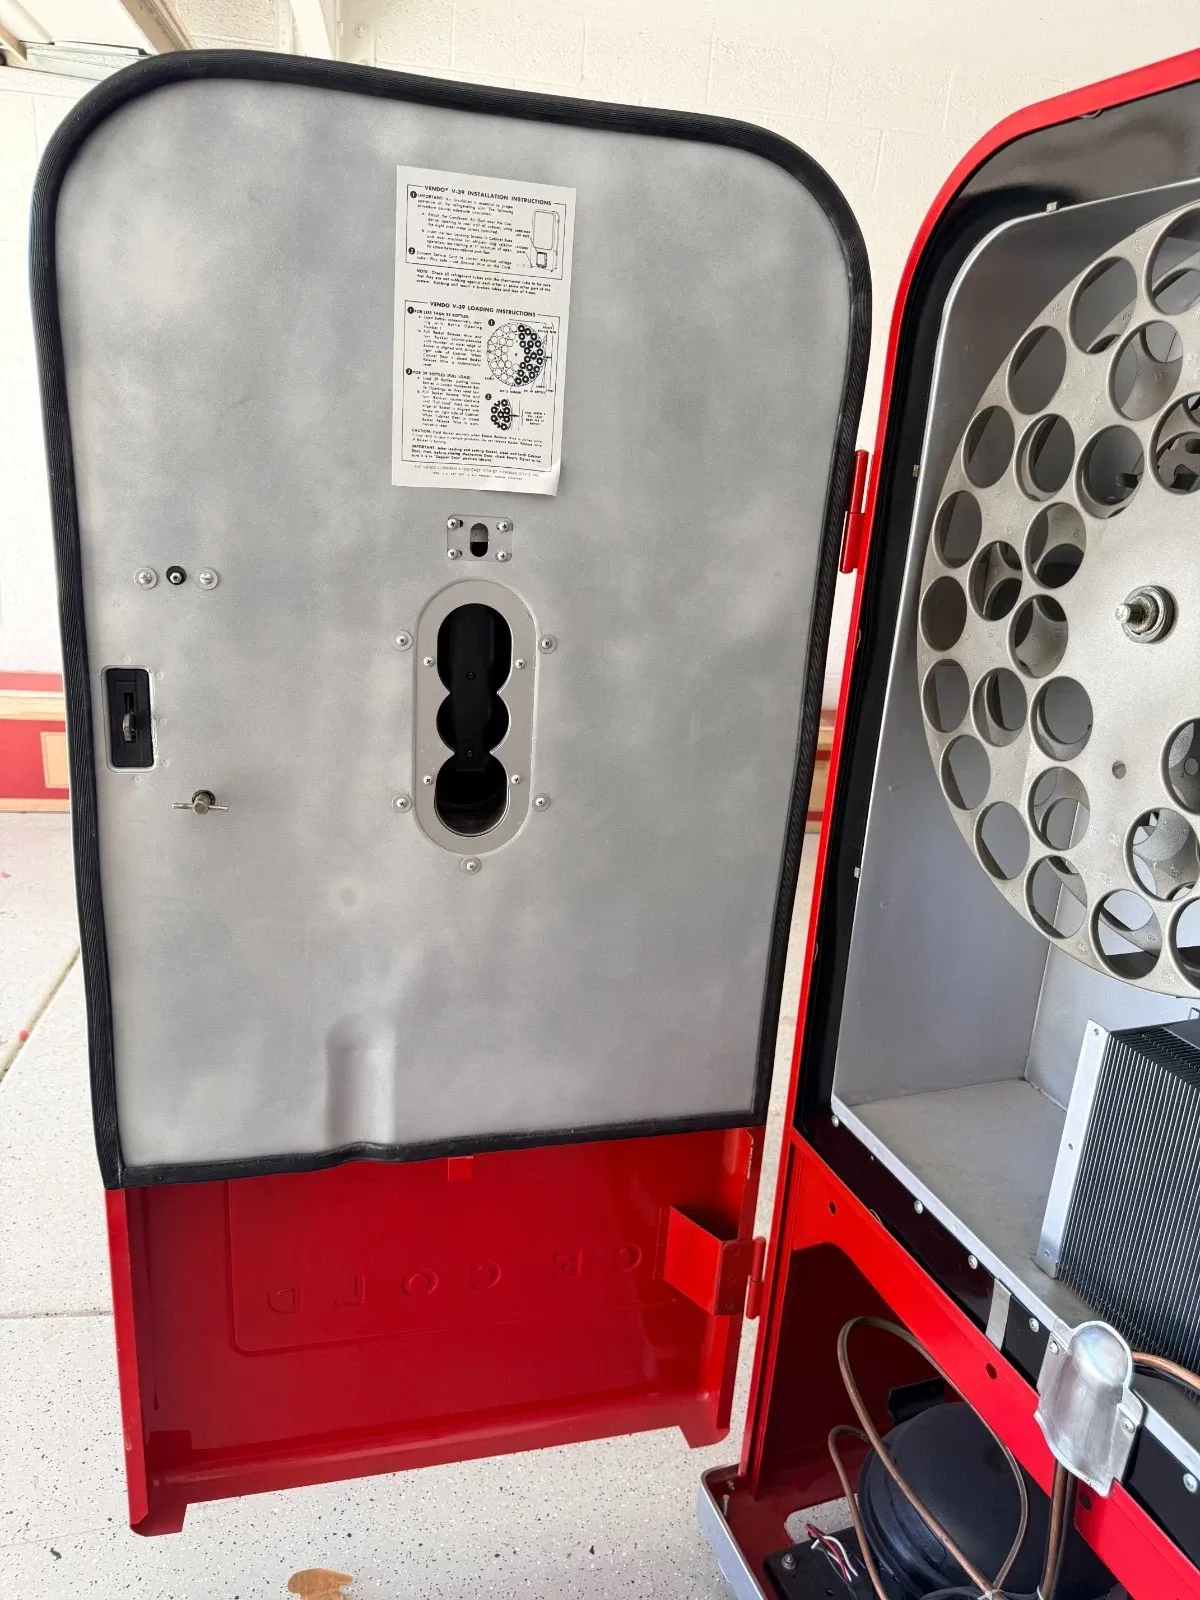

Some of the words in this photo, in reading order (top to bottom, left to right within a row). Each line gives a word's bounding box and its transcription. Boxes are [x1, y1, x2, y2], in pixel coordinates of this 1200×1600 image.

[468, 190, 508, 200] INSTALLATION
[511, 196, 552, 206] INSTRUCTIONS
[496, 308, 535, 317] INSTRUCTIONS
